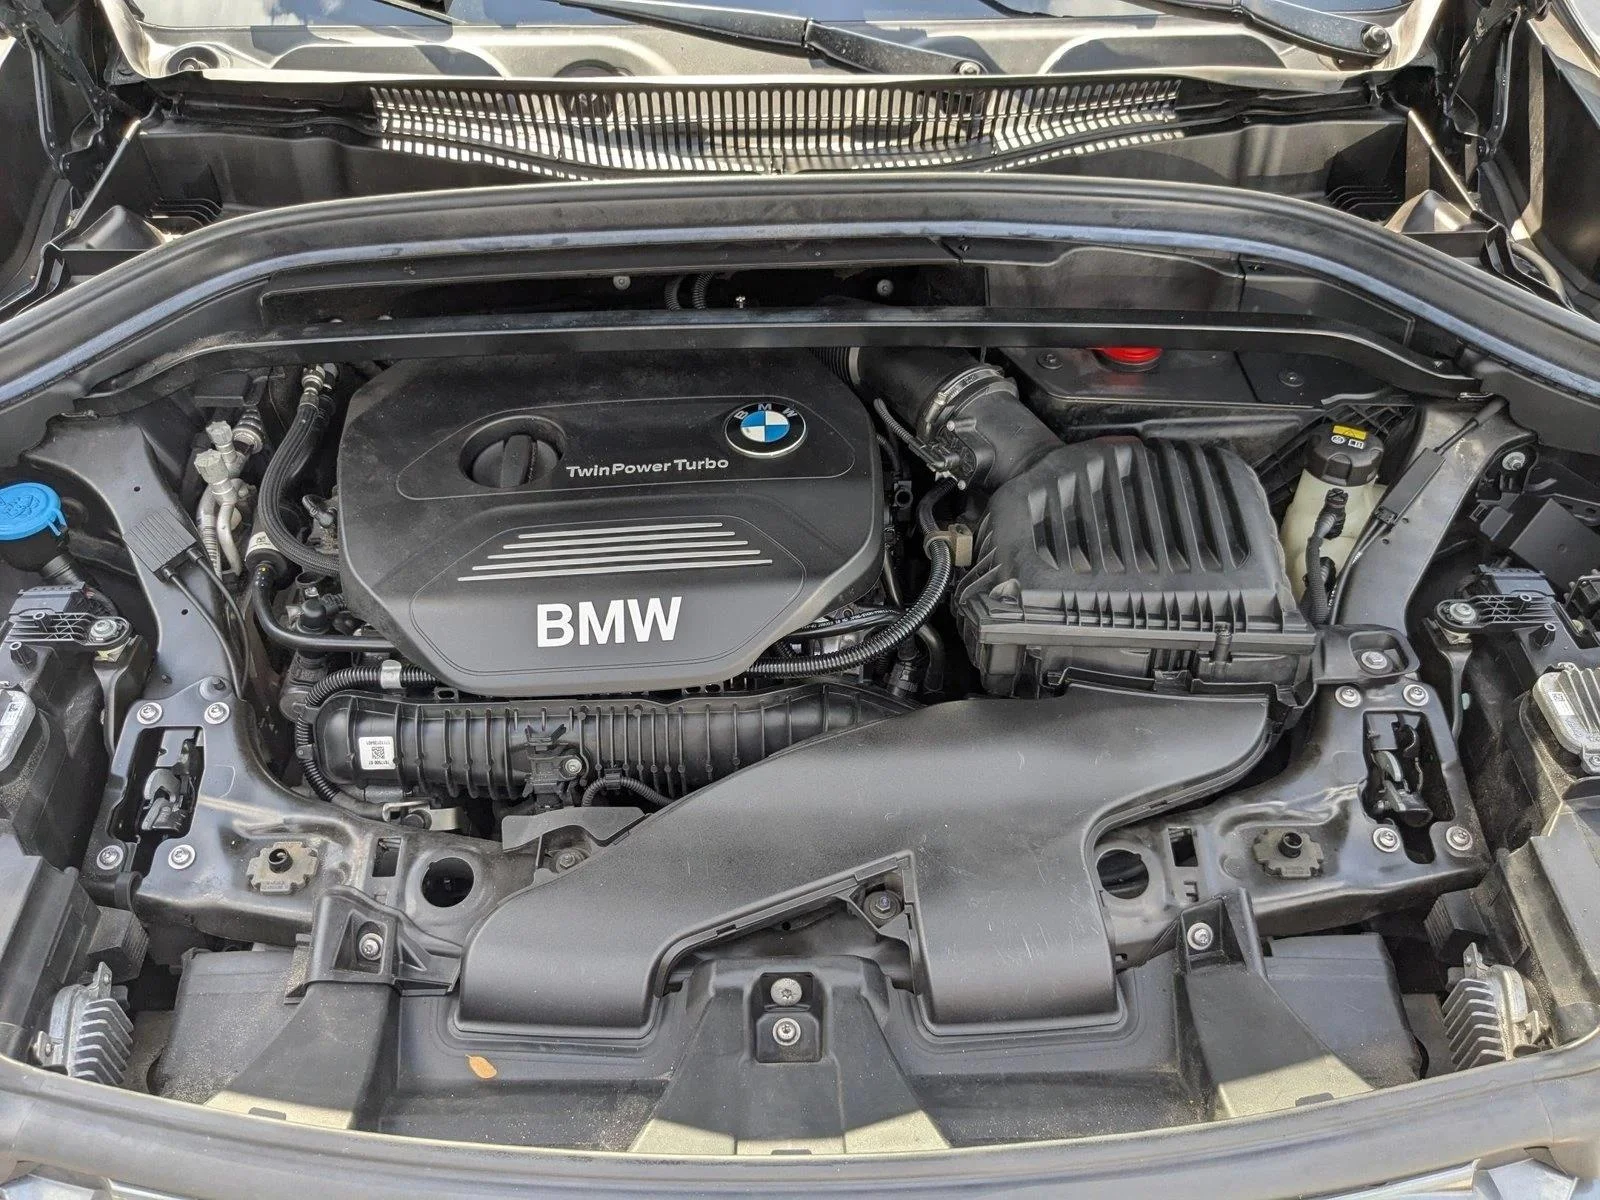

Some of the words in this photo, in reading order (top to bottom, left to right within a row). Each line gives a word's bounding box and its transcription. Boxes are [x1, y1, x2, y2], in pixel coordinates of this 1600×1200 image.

[734, 403, 798, 420] BMW
[673, 457, 729, 472] Turbo
[537, 596, 683, 648] BMW
